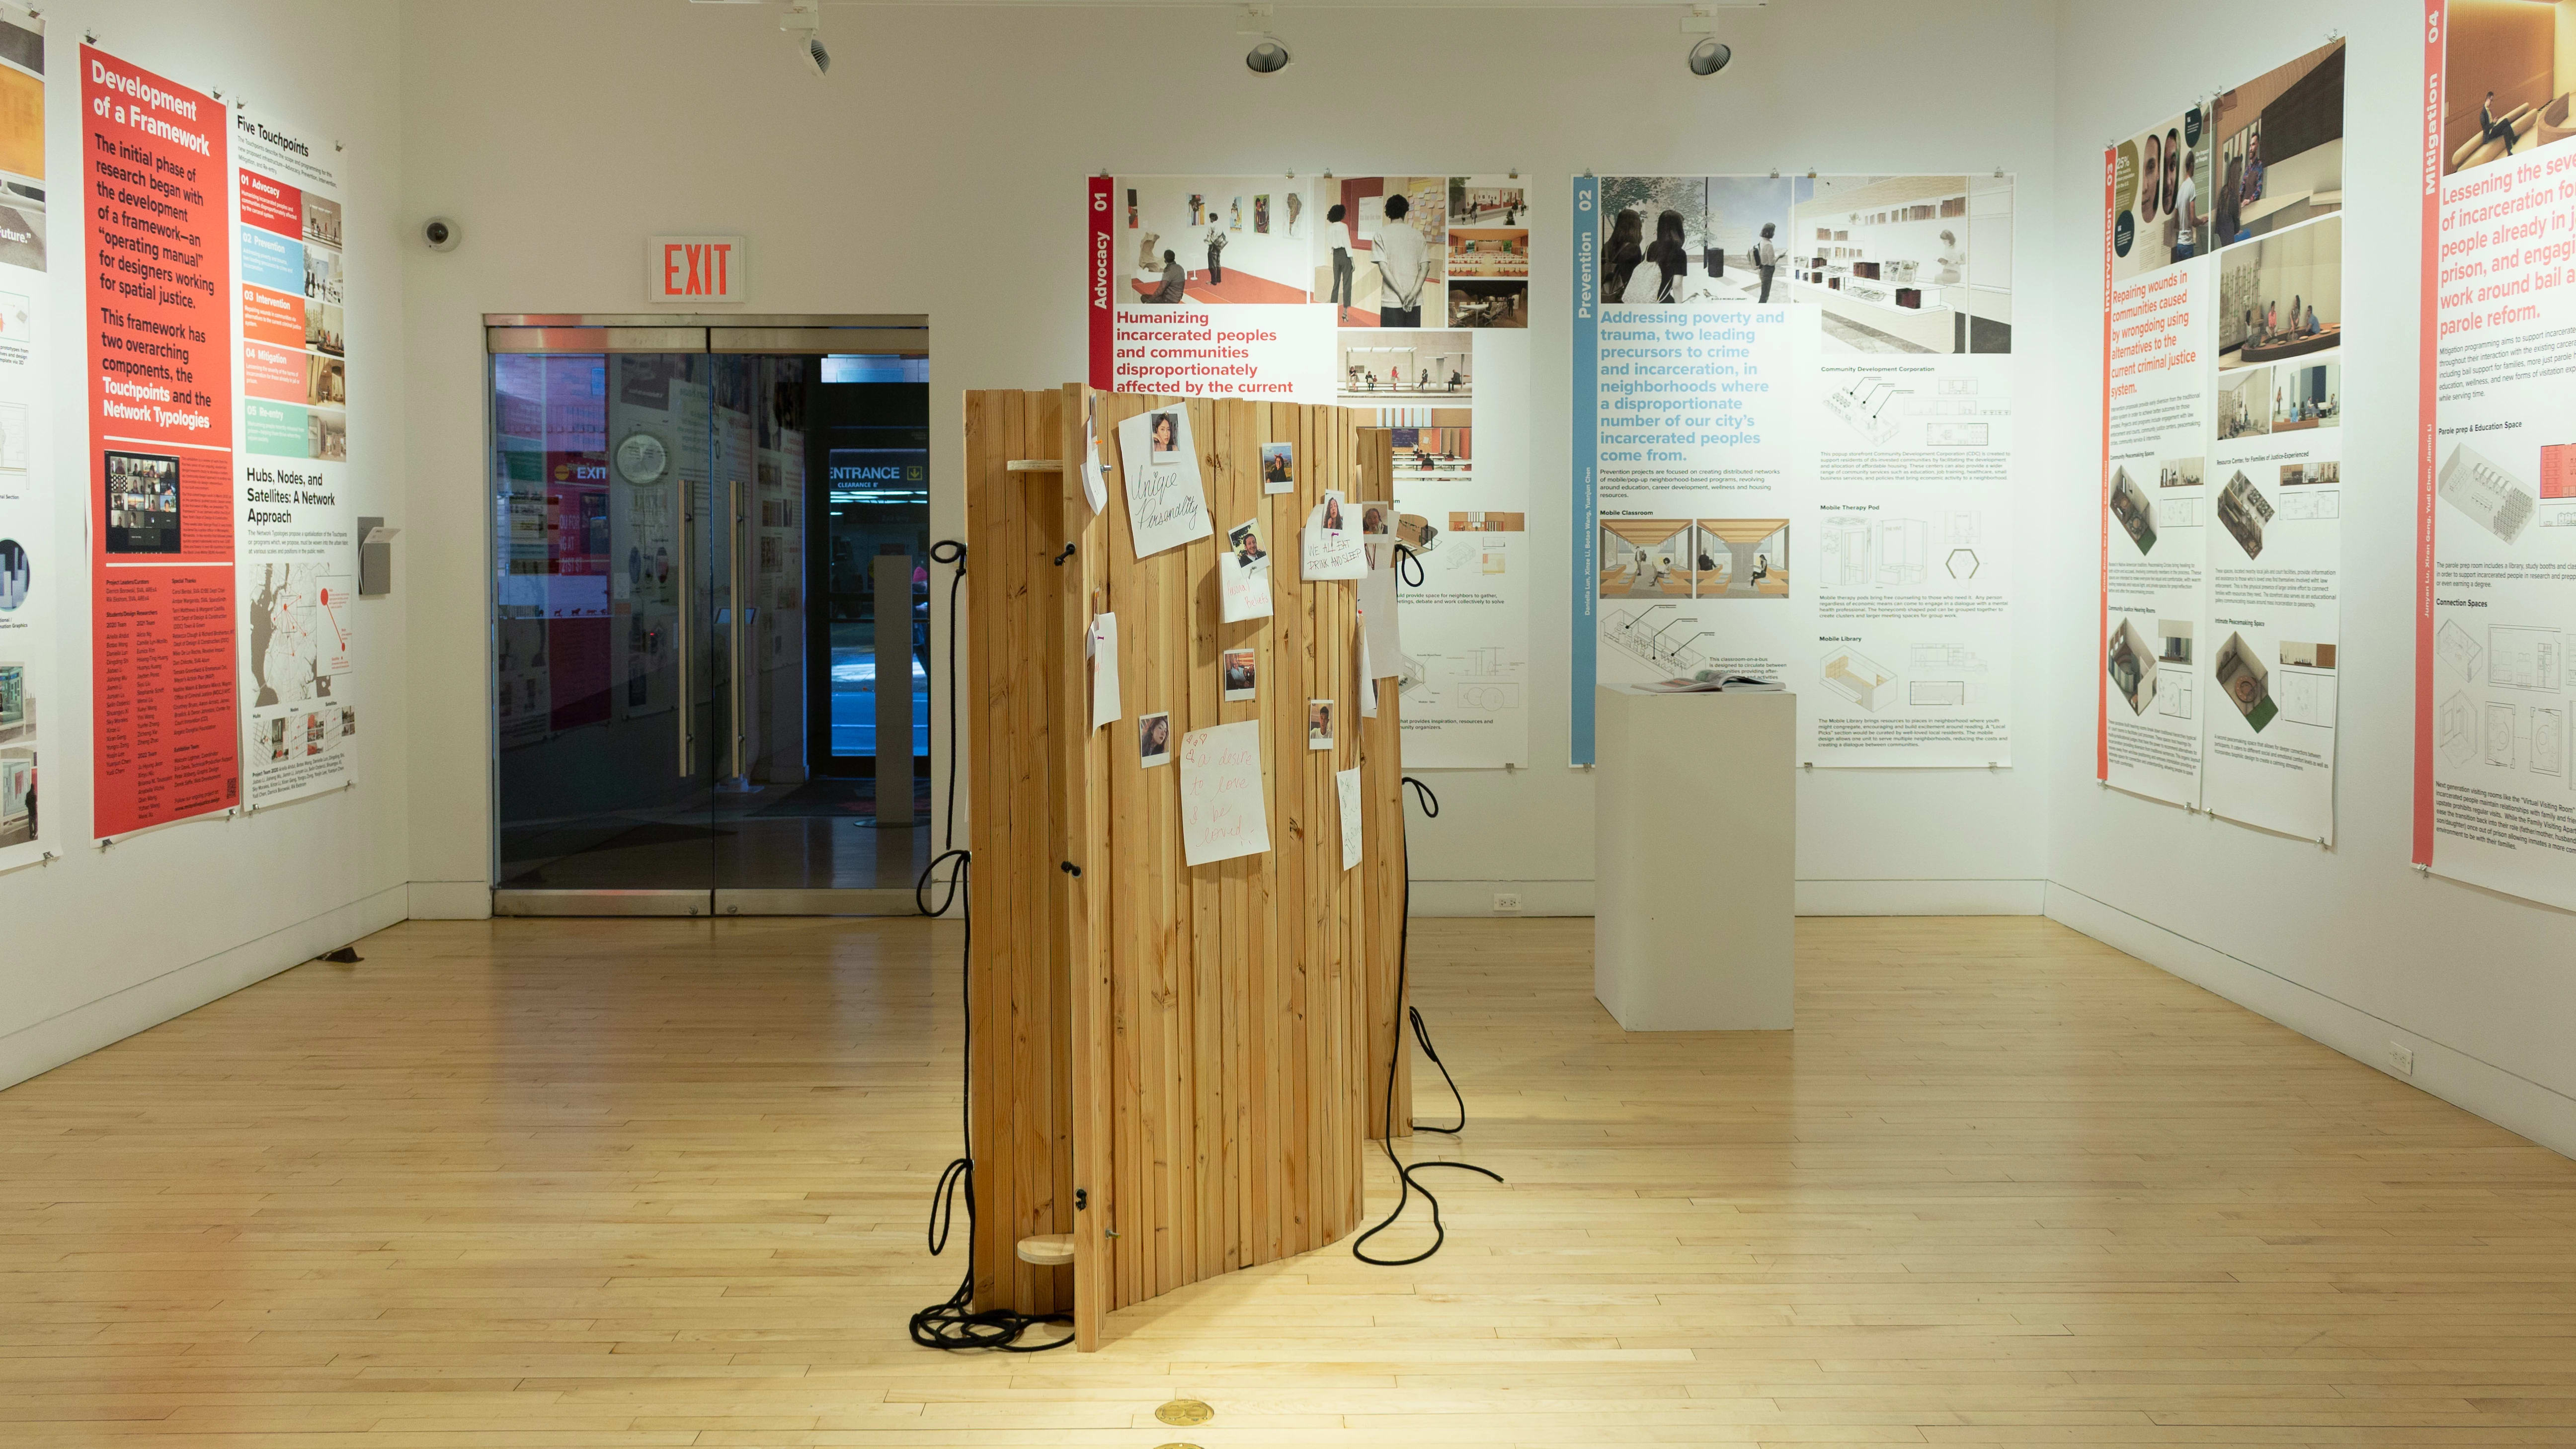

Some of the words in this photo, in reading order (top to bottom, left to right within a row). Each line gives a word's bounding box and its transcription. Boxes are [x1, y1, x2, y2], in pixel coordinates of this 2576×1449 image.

[2428, 10, 2438, 43] 04
[92, 59, 196, 121] Development
[93, 96, 110, 118] of
[115, 105, 125, 124] a
[130, 106, 210, 157] Framework
[238, 114, 255, 135] Five
[257, 123, 309, 157] Touchpoints
[2426, 74, 2438, 195] Mitigation
[94, 132, 116, 155] The
[120, 141, 152, 166] initial
[156, 156, 184, 178] phase
[187, 168, 196, 182] of
[96, 160, 146, 187] research
[150, 173, 180, 198] began
[183, 188, 203, 206] with
[241, 174, 248, 185] 01
[252, 178, 280, 198] Advocacy
[2107, 163, 2113, 186] 03
[2443, 173, 2512, 206] Lessening
[2517, 163, 2541, 183] the
[96, 181, 115, 200] the
[118, 188, 187, 222] development
[1095, 193, 1107, 211] 01
[1579, 190, 1591, 211] 02
[2442, 211, 2456, 231] of
[2459, 189, 2553, 227] incarceration
[98, 205, 109, 221] of
[112, 212, 118, 224] a
[121, 210, 201, 247] framework—an
[2441, 231, 2488, 262] people
[2492, 216, 2547, 245] already
[2552, 211, 2565, 230] in
[98, 226, 159, 260] “operating
[162, 247, 203, 267] manual”
[243, 233, 251, 243] 02
[254, 236, 285, 253] Prevention
[665, 244, 731, 295] EXIT
[1095, 232, 1110, 309] Advocacy
[1579, 233, 1591, 318] Prevention
[2113, 284, 2146, 304] Repairing
[2148, 273, 2177, 293] wounds
[2179, 270, 2187, 284] in
[244, 290, 253, 301] 03
[256, 293, 291, 310] Intervention
[2112, 300, 2157, 322] communities
[2159, 289, 2187, 309] caused
[1117, 311, 1208, 326] Humanizing
[1600, 311, 1687, 326] Addressing
[1693, 312, 1751, 326] poverty
[1756, 311, 1784, 323] and
[2112, 329, 2120, 343] by
[2122, 317, 2165, 338] wrongdoing
[2167, 311, 2189, 327] using
[2440, 312, 2483, 340] parole
[2488, 305, 2540, 326] reform.
[1117, 327, 1211, 341] incarcerated
[1217, 329, 1277, 343] peoples
[1600, 329, 1660, 342] trauma,
[1665, 329, 1693, 340] two
[1699, 328, 1755, 343] leading
[2112, 340, 2152, 360] alternatives
[2154, 338, 2162, 350] to
[2164, 333, 2176, 347] the
[246, 348, 255, 358] 04
[258, 350, 287, 365] Mitigation
[1117, 346, 1145, 358] and
[1150, 345, 1249, 358] communities
[1601, 347, 1682, 361] precursors
[1687, 346, 1702, 358] to
[1707, 345, 1749, 357] crime
[1117, 362, 1258, 378] disproportionately
[1601, 363, 1629, 375] and
[1635, 362, 1738, 376] incarceration,
[1744, 362, 1757, 374] in
[2111, 362, 2135, 378] current
[2137, 354, 2167, 373] criminal
[2168, 350, 2196, 370] justice
[102, 376, 170, 402] Touchpoints
[172, 390, 191, 404] and
[194, 391, 211, 407] the
[1117, 380, 1180, 393] affected
[1186, 381, 1204, 396] by
[1208, 381, 1233, 393] the
[1238, 382, 1293, 393] current
[1601, 380, 1716, 395] neighborhoods
[1721, 380, 1769, 392] where
[2111, 384, 2137, 400] system.
[104, 400, 151, 421] Network
[153, 406, 212, 430] Typologies.
[247, 405, 256, 415] 05
[259, 407, 284, 421] Re-entry
[1601, 400, 1610, 409] a
[1614, 397, 1742, 412] disproportionate
[2475, 422, 2502, 431] Education
[2504, 421, 2522, 430] Space
[247, 467, 274, 484] Hubs,
[277, 470, 305, 485] Nodes,
[308, 473, 322, 486] and
[577, 466, 606, 479] EXIT
[247, 487, 291, 503] Satellites:
[293, 490, 300, 503] A
[302, 491, 335, 505] Network
[1131, 465, 1178, 505] Unique
[247, 508, 291, 526] Approach
[1135, 495, 1198, 530] Personality
[1307, 559, 1329, 570] DRINK
[1331, 557, 1342, 566] AND
[1342, 549, 1362, 563] SLEEP
[1308, 545, 1319, 556] WE
[1323, 543, 1336, 554] ALL
[1336, 540, 1350, 551] EAT
[2436, 598, 2466, 606] Connection
[2467, 599, 2488, 608] Spaces
[1198, 753, 1211, 768] a
[1219, 748, 1252, 766] desire
[1190, 777, 1203, 796] to
[1210, 776, 1249, 802] love
